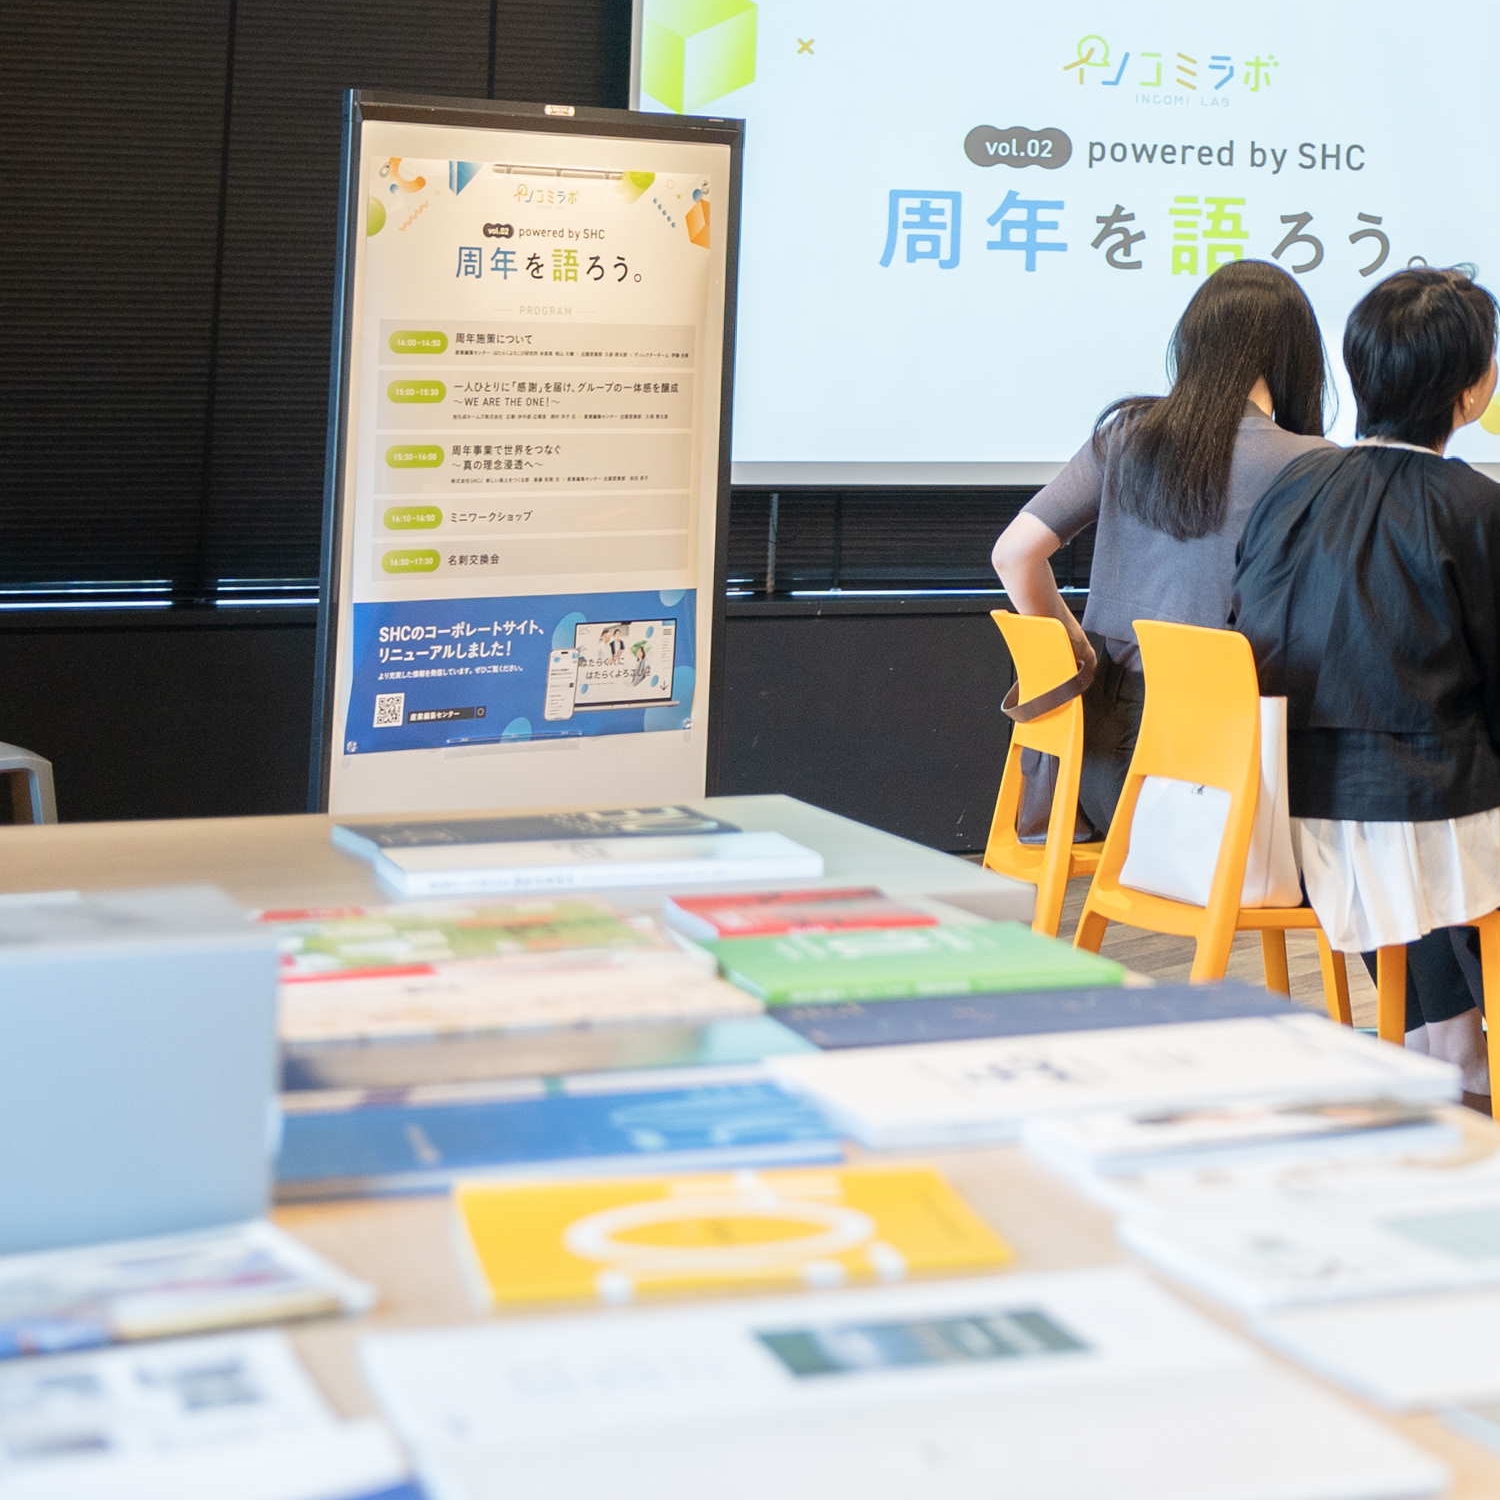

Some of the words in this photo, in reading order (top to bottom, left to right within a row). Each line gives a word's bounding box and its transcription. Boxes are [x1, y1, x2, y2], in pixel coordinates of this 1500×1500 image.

[1135, 94, 1189, 106] INCOMI
[1200, 97, 1230, 107] LAB
[985, 138, 1053, 159] vol.02
[1088, 138, 1235, 169] powered
[1250, 141, 1287, 175] by
[1298, 142, 1365, 171] SHC
[488, 226, 510, 236] vol.02
[518, 228, 564, 239] powered
[568, 228, 581, 241] by
[583, 229, 606, 240] SHC
[879, 188, 1428, 278] 周年を語ろう。
[455, 246, 642, 283] 周年を語ろう。
[519, 305, 573, 316] PROGRAM
[455, 332, 533, 345] 周年施策について
[454, 381, 679, 394] 一人ひとりに「感謝」を届け、グループの一体感を醸成
[482, 397, 501, 407] ARE
[504, 397, 522, 407] THE
[451, 445, 562, 456] 周年事業で世界をつなぐ
[450, 510, 533, 523] ミニワークショップ
[448, 553, 500, 566] 名刺交換会
[378, 619, 545, 643] SHCのコーポレートサイト、
